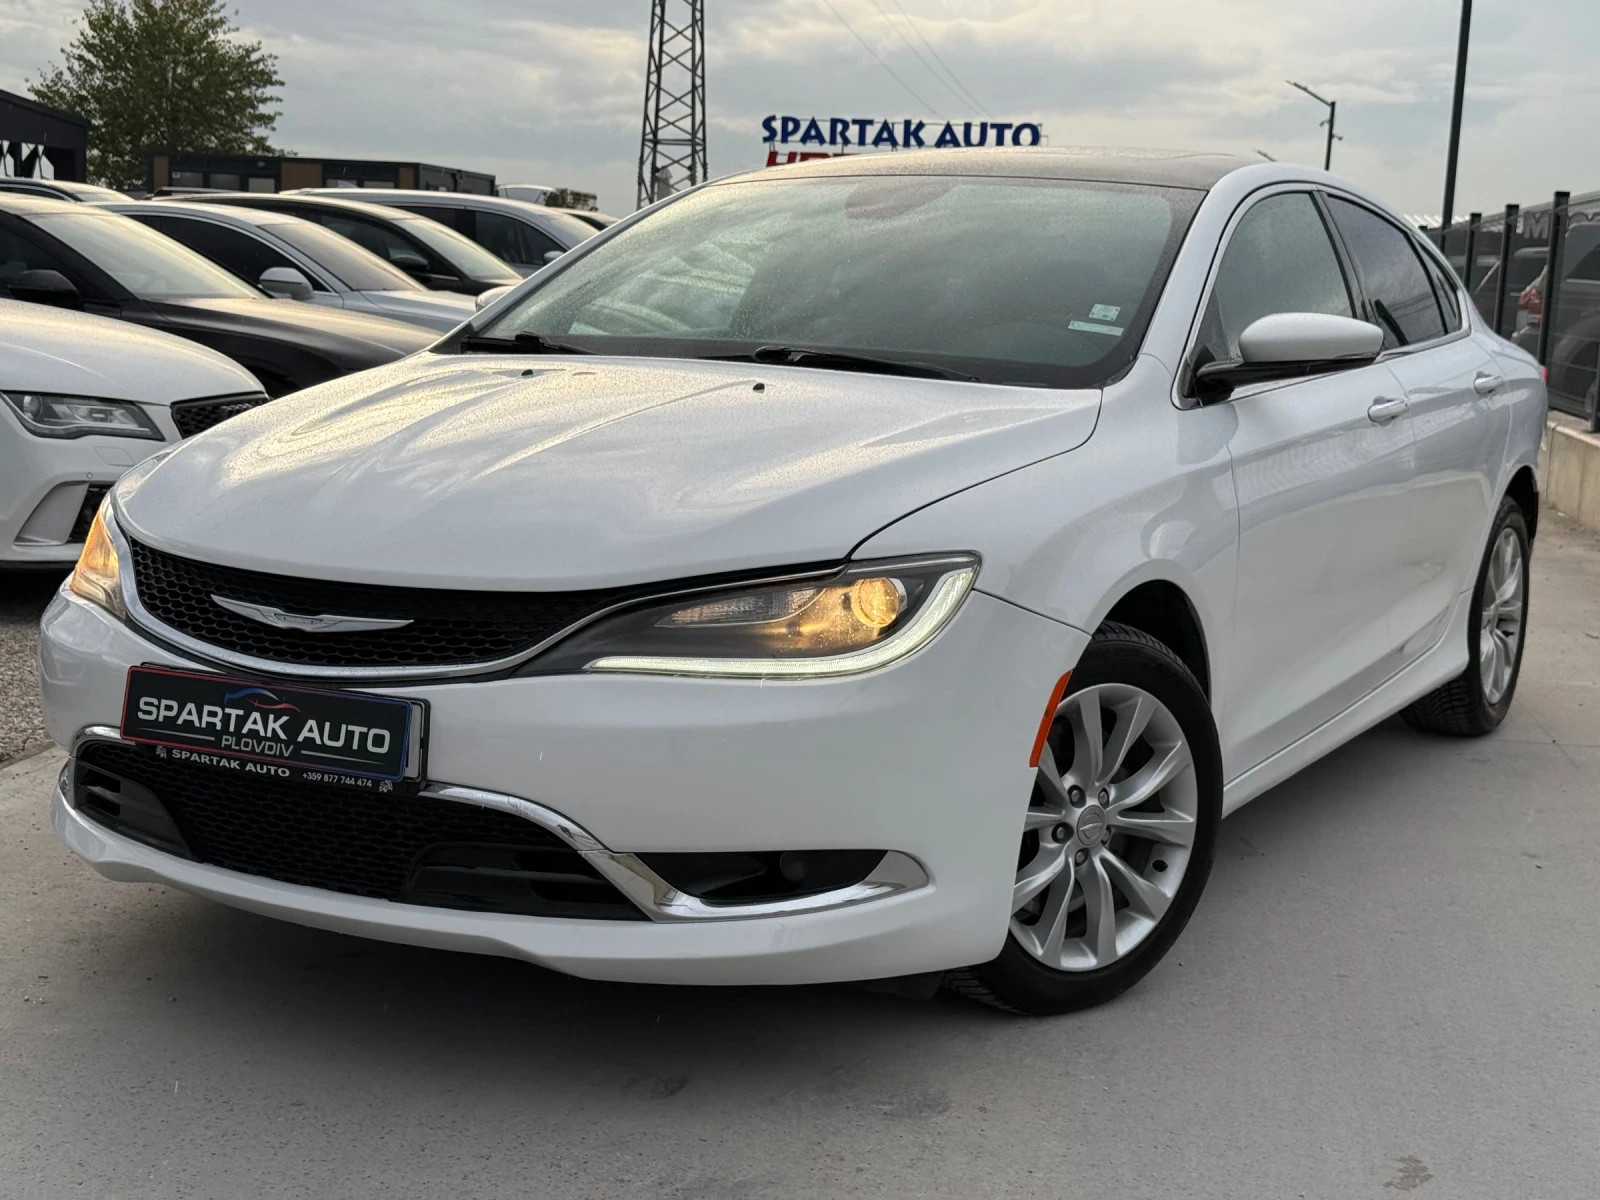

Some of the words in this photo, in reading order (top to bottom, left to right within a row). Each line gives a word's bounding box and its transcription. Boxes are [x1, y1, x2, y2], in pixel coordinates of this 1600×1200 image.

[762, 115, 926, 148] SPARTAK
[934, 121, 1041, 148] AUTO
[137, 696, 291, 740] SPARTAK
[296, 719, 391, 754] AUTO
[221, 734, 294, 757] PLOVDIV
[171, 749, 241, 770] SPARTAK
[245, 762, 290, 777] AUTO
[302, 771, 322, 781] +359
[323, 774, 338, 784] 877
[340, 776, 355, 785] 744
[356, 777, 373, 788] 474
